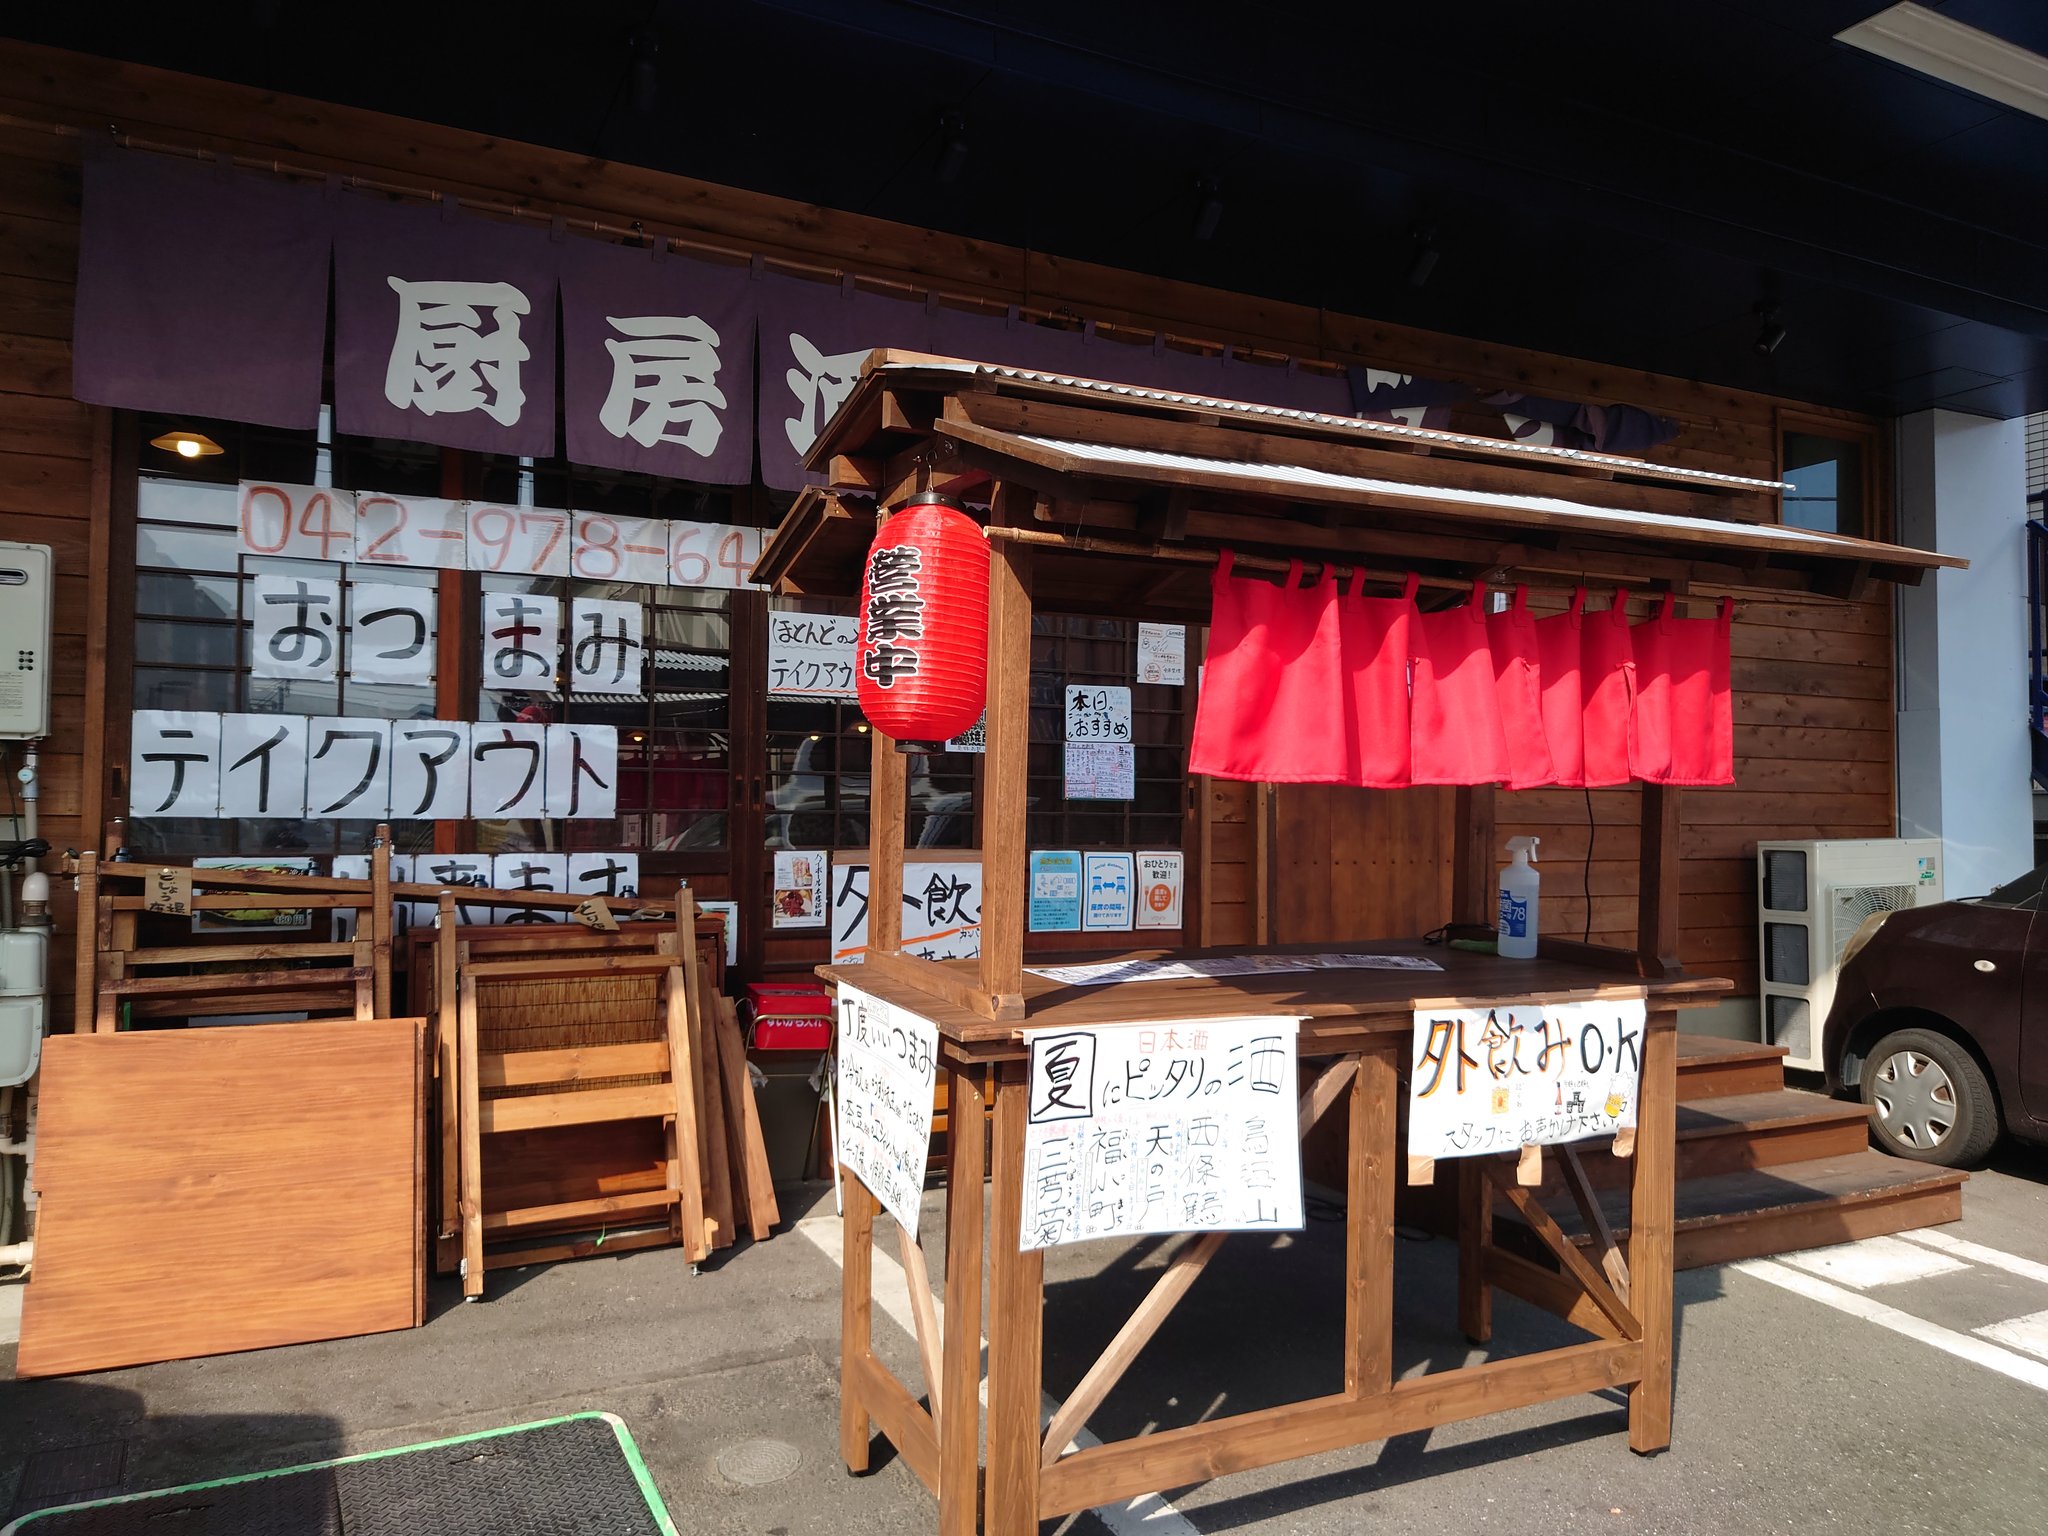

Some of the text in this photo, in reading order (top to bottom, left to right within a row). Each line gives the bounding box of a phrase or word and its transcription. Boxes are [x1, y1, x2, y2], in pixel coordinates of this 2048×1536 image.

[242, 486, 773, 591] 042-978-64
[265, 581, 640, 685] おつまみ
[864, 546, 925, 688] 営業中
[771, 659, 853, 689] テイクアウ
[142, 725, 608, 817] テイクアウト
[1074, 718, 1128, 739] おすすめ
[1143, 859, 1178, 869] おひとりさま
[1512, 907, 1526, 920] 78
[1138, 1028, 1208, 1054] 日本酒
[1089, 1126, 1122, 1231] 福小町
[1138, 1124, 1173, 1223] 天の戸
